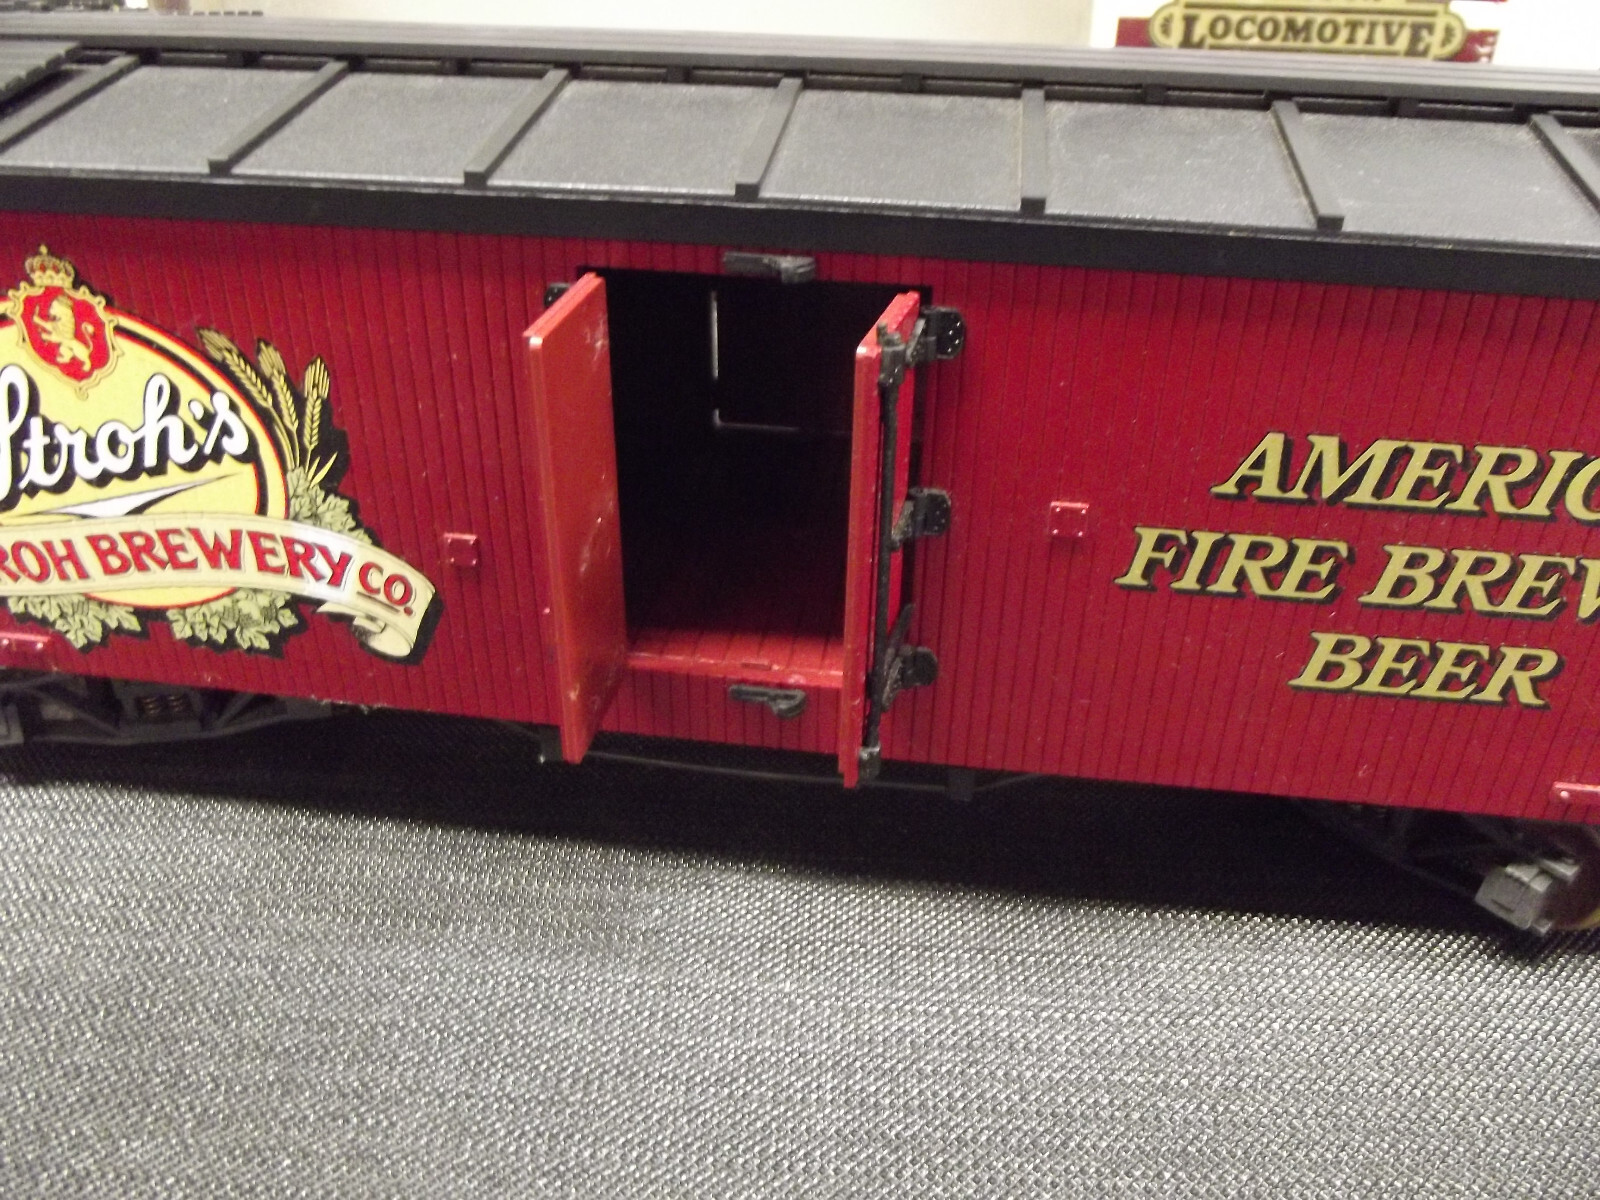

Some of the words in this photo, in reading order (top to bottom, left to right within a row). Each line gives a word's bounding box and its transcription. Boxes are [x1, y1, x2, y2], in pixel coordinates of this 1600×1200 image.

[1178, 14, 1436, 57] LOCOMOTIVE
[86, 526, 353, 588] BREWERY
[1113, 525, 1350, 602] FIRE
[1358, 543, 1600, 624] BRE
[1287, 630, 1560, 708] BEER
